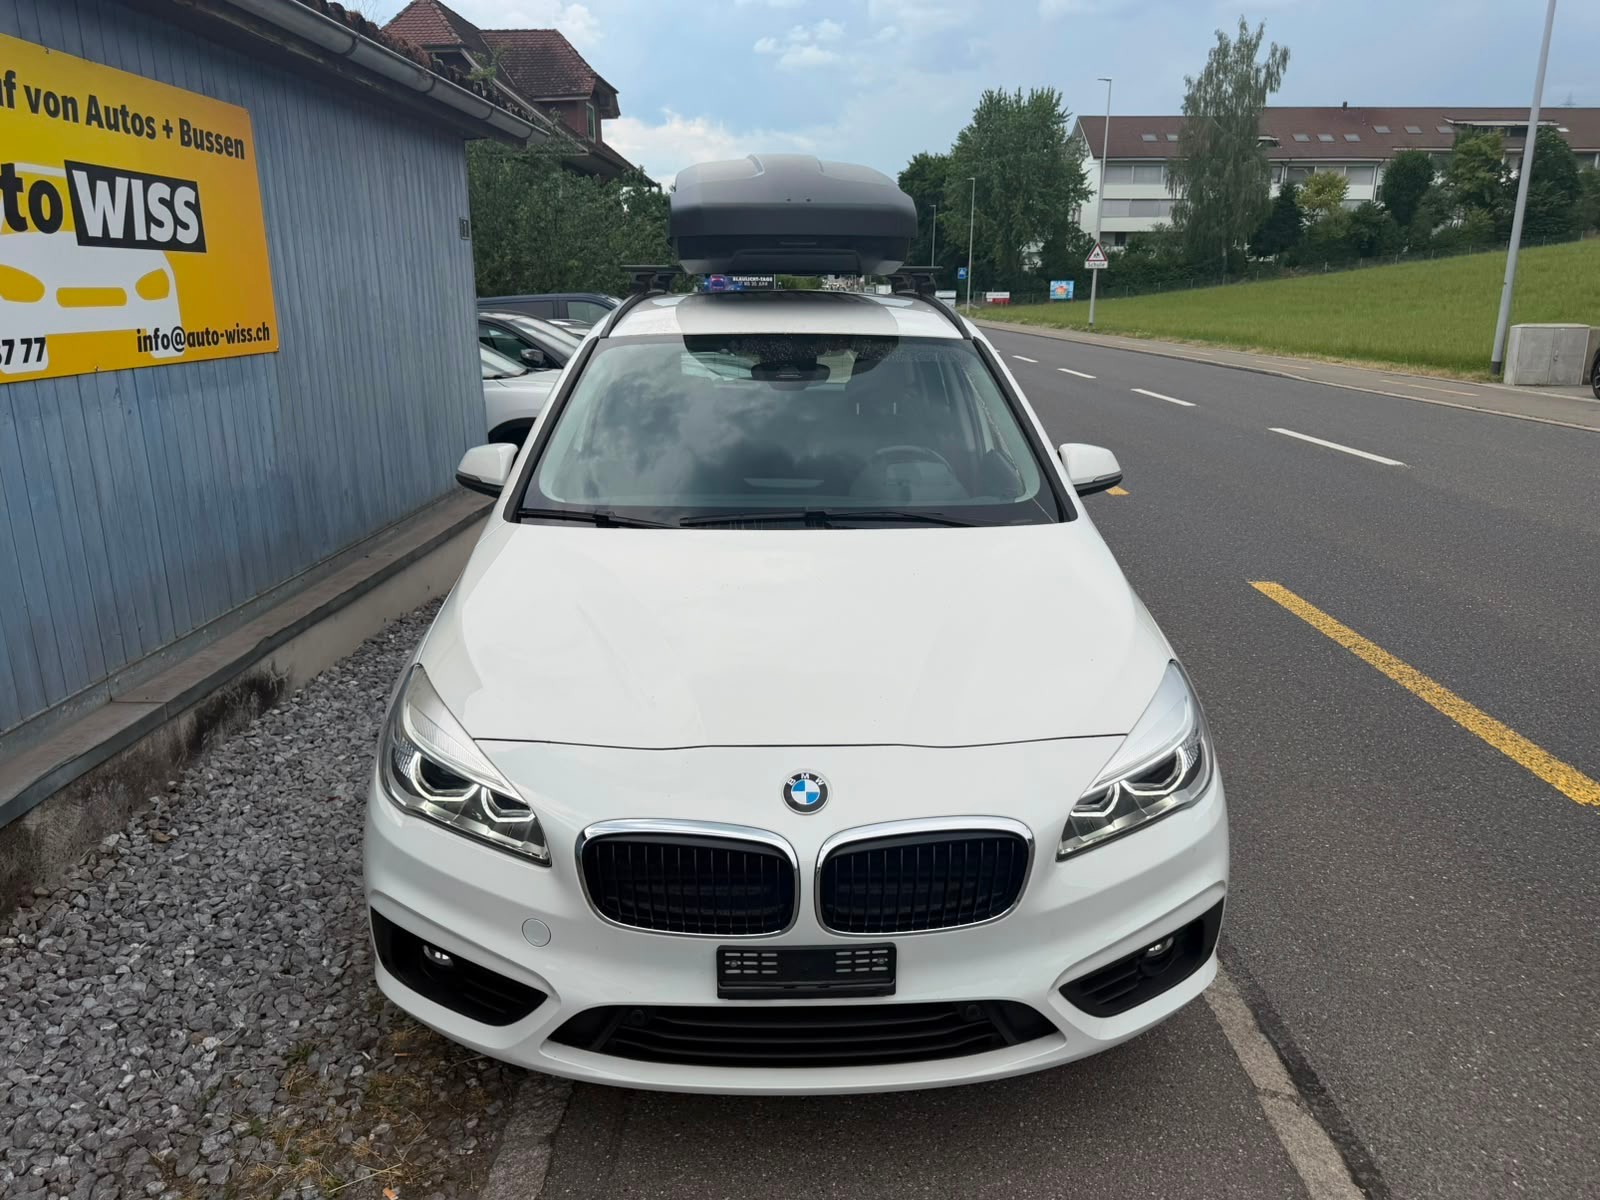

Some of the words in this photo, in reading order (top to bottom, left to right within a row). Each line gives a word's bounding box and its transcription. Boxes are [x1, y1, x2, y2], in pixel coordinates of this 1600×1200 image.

[0, 70, 16, 109] f
[23, 85, 79, 123] von
[87, 96, 156, 139] Autos
[163, 119, 173, 139] +
[179, 118, 245, 160] Bussen
[72, 169, 199, 244] WISS
[0, 338, 15, 366] 7
[20, 336, 46, 364] 77
[137, 322, 270, 353] info@auto-wiss.ch
[787, 773, 825, 786] BMW
